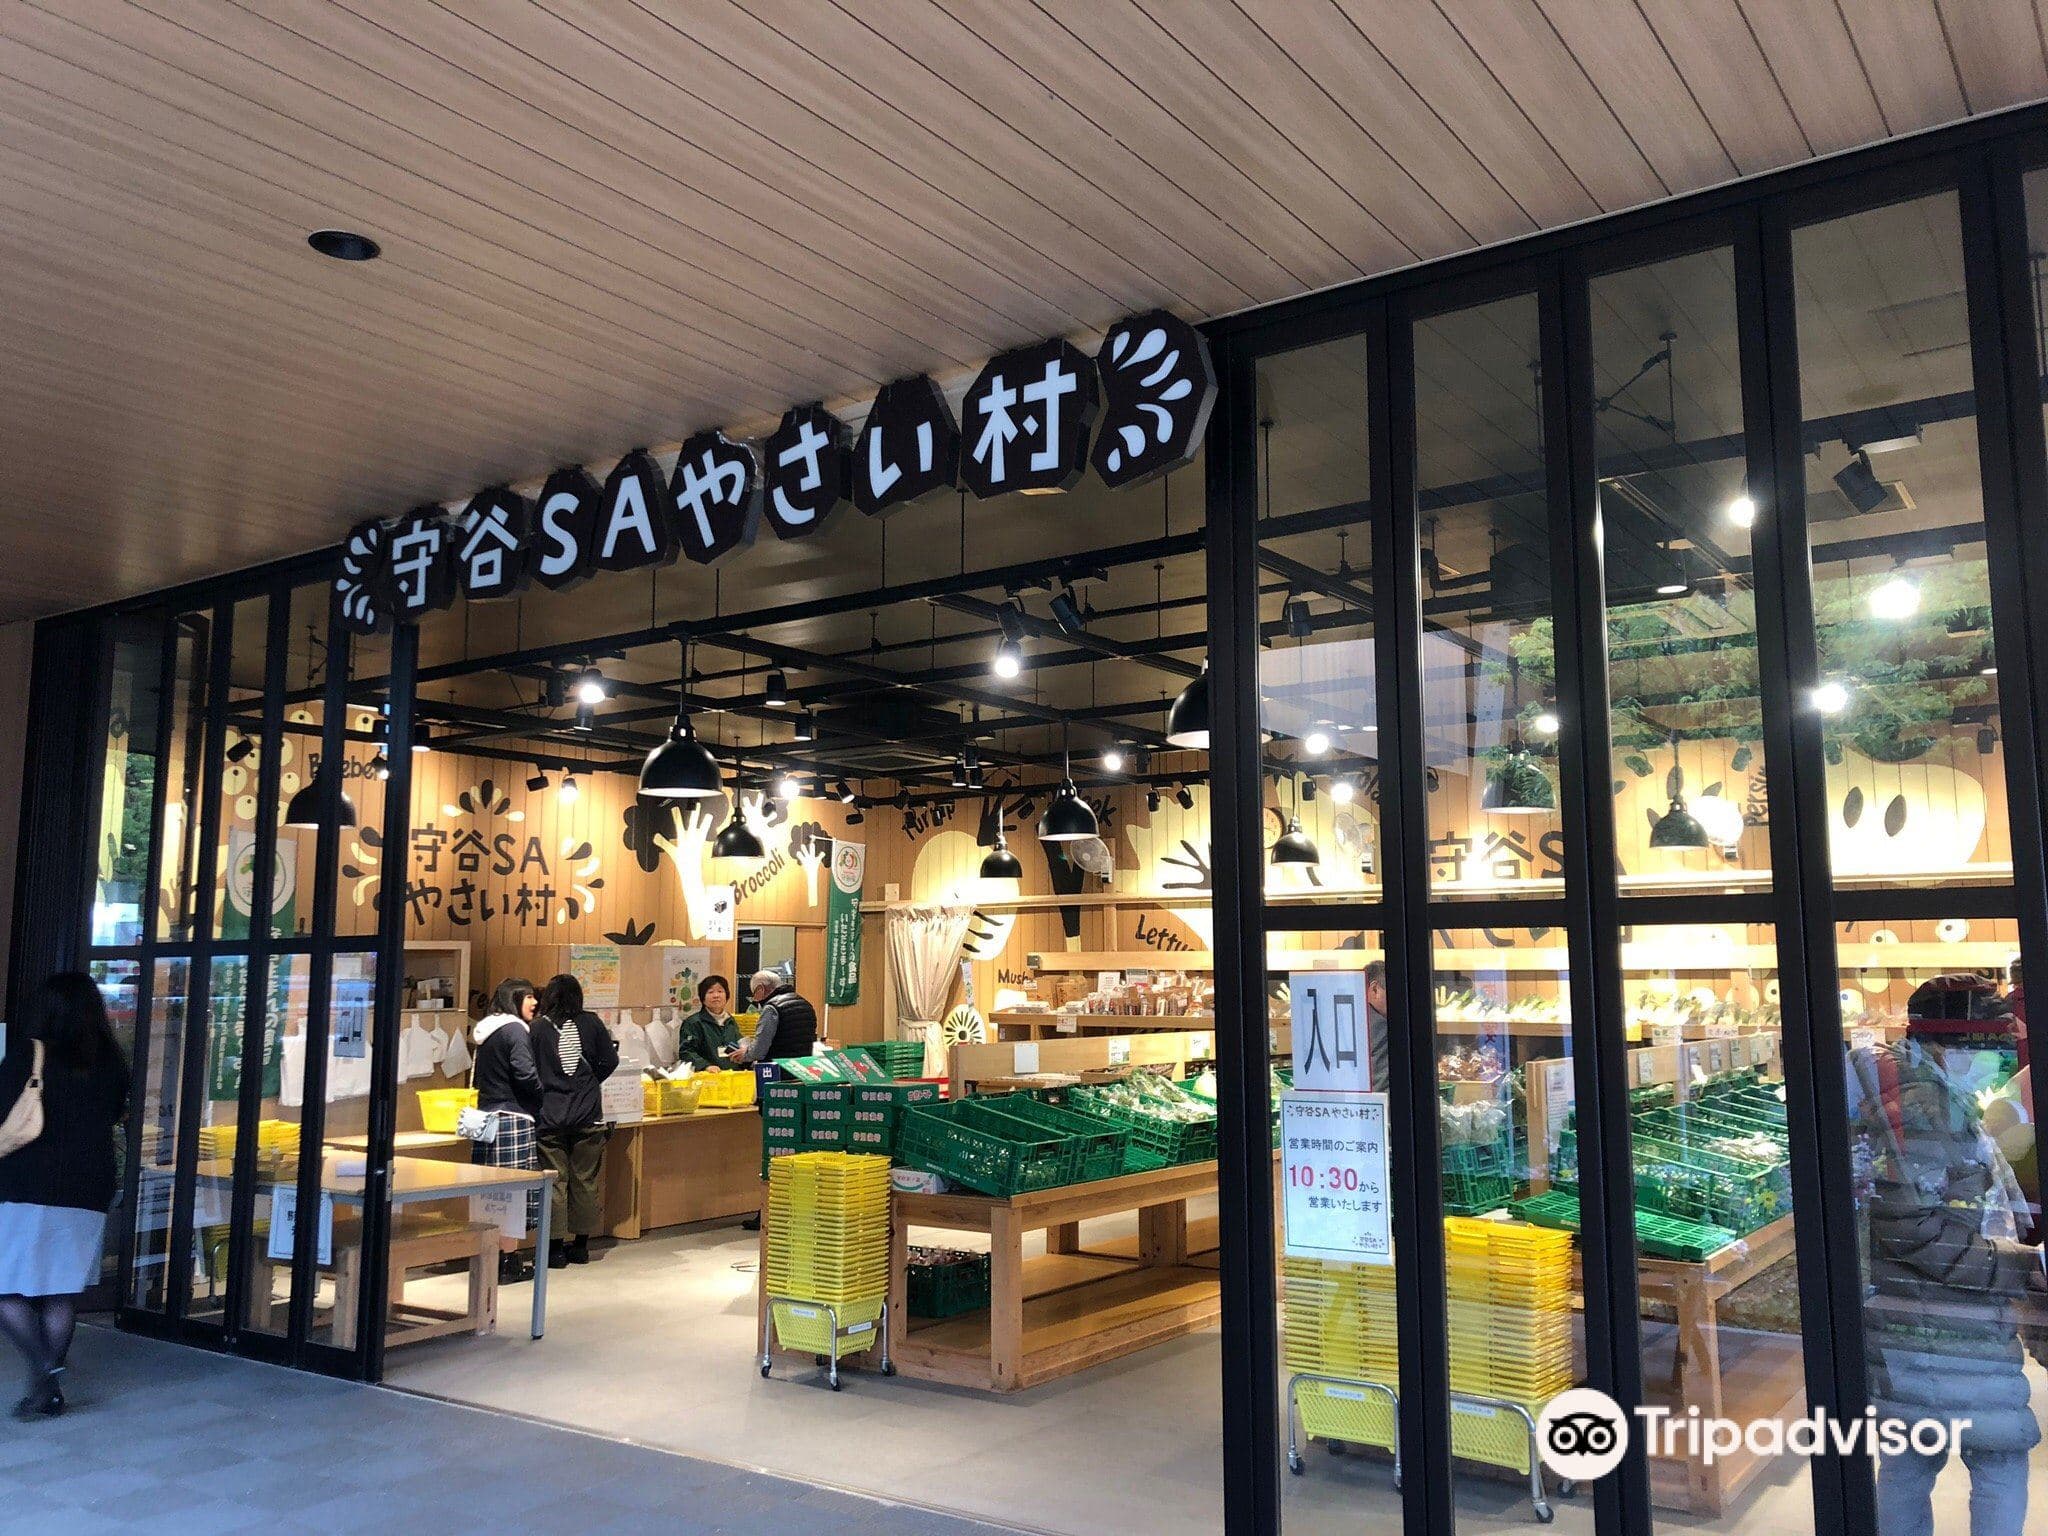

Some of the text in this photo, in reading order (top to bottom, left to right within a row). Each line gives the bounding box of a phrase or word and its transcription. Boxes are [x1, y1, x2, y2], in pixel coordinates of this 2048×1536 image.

[390, 359, 1078, 608] 守谷SAやさい村
[1743, 765, 1769, 827] Persi
[410, 823, 550, 876] 守谷SA
[404, 878, 556, 927] やさい村
[729, 848, 785, 906] Broccoli
[1135, 913, 1197, 951] Lettu
[1303, 988, 1358, 1075] 入口
[1289, 1138, 1379, 1153] 営業時間のご案内
[1308, 1196, 1382, 1213] 営業いたします
